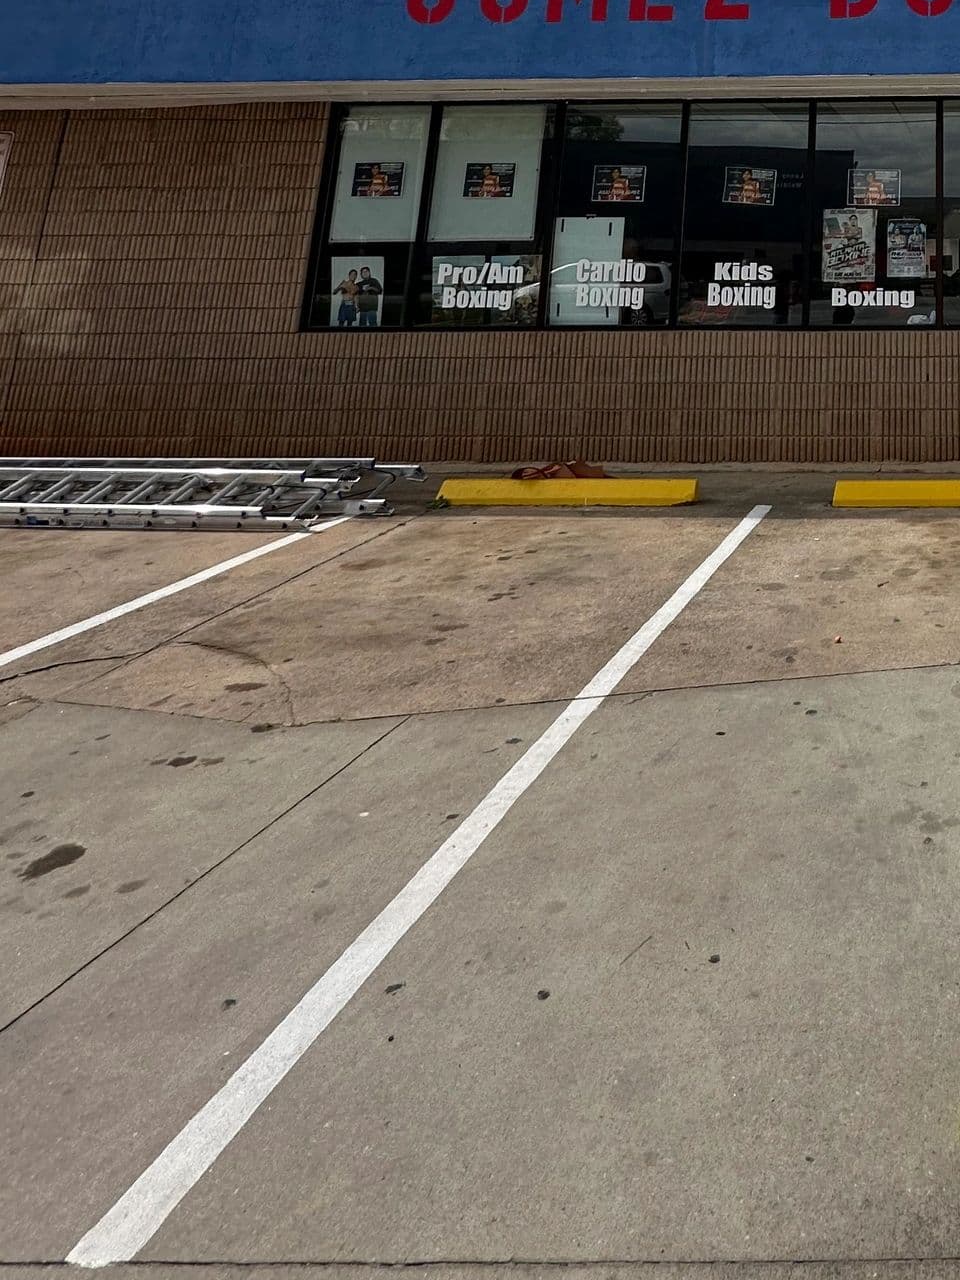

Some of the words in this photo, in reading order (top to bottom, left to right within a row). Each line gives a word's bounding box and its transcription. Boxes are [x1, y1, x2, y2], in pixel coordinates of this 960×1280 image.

[437, 262, 524, 285] Pro/Am
[575, 259, 646, 283] Cardio
[714, 262, 774, 281] Kids
[442, 287, 514, 311] Boxing
[575, 283, 645, 310] Boxing
[706, 282, 776, 309] Boxing
[831, 287, 916, 309] Boxing
